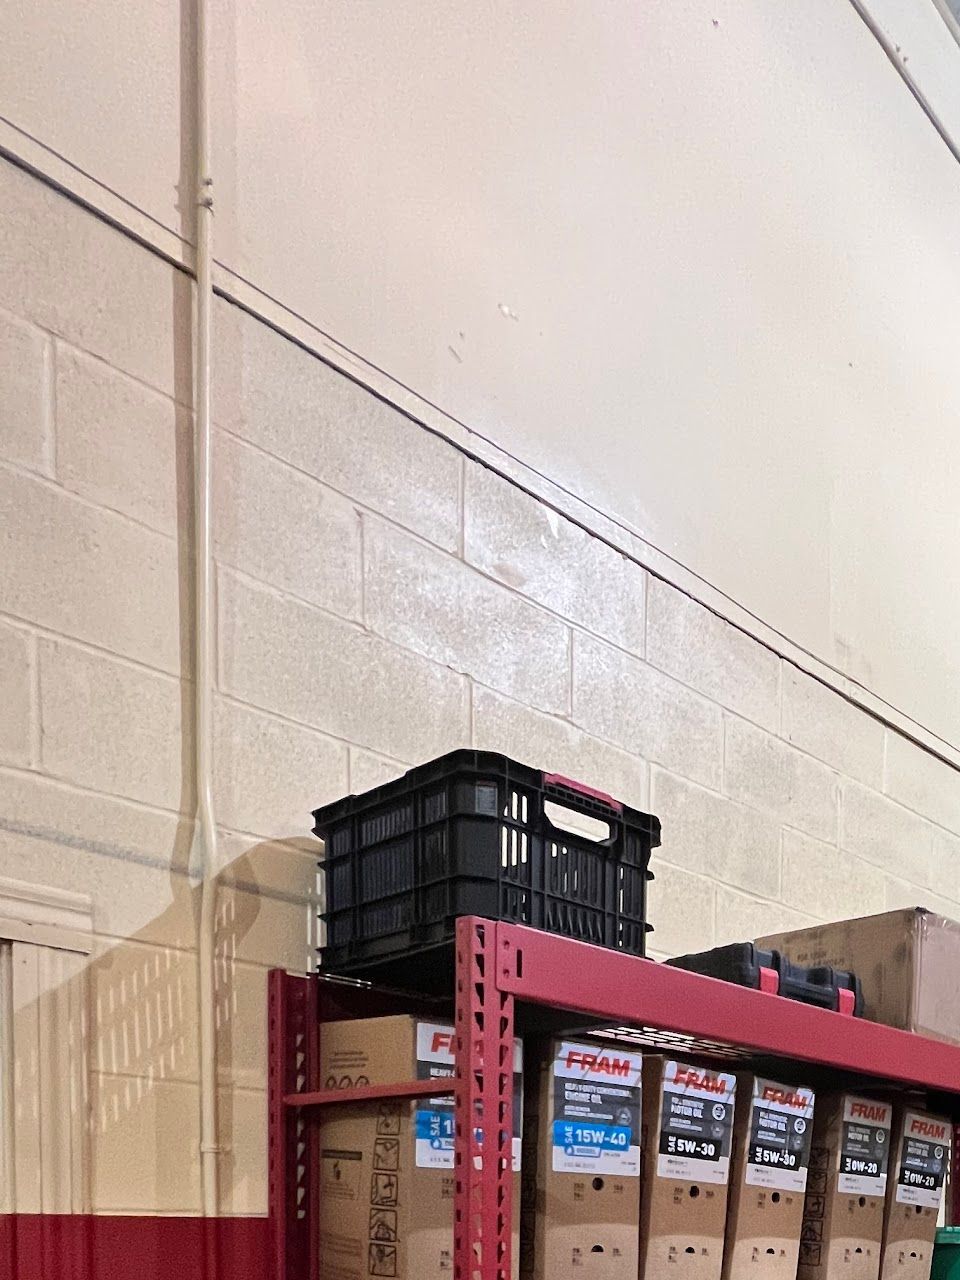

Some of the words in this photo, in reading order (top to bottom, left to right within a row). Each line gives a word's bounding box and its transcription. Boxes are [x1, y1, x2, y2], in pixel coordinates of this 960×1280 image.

[565, 1050, 631, 1077] FRAM
[672, 1067, 727, 1095] FRAM
[763, 1086, 808, 1110] FRAM
[850, 1102, 887, 1123] FRAM
[429, 1116, 440, 1136] SAE
[564, 1126, 574, 1144] SAE
[575, 1128, 627, 1146] 15W-40
[910, 1119, 946, 1140] FRAM
[668, 1135, 677, 1153] SAE
[676, 1138, 716, 1157] 5W-30
[763, 1149, 797, 1167] 5W-30
[851, 1159, 878, 1174] 0W-20
[909, 1172, 935, 1187] 0W-20
